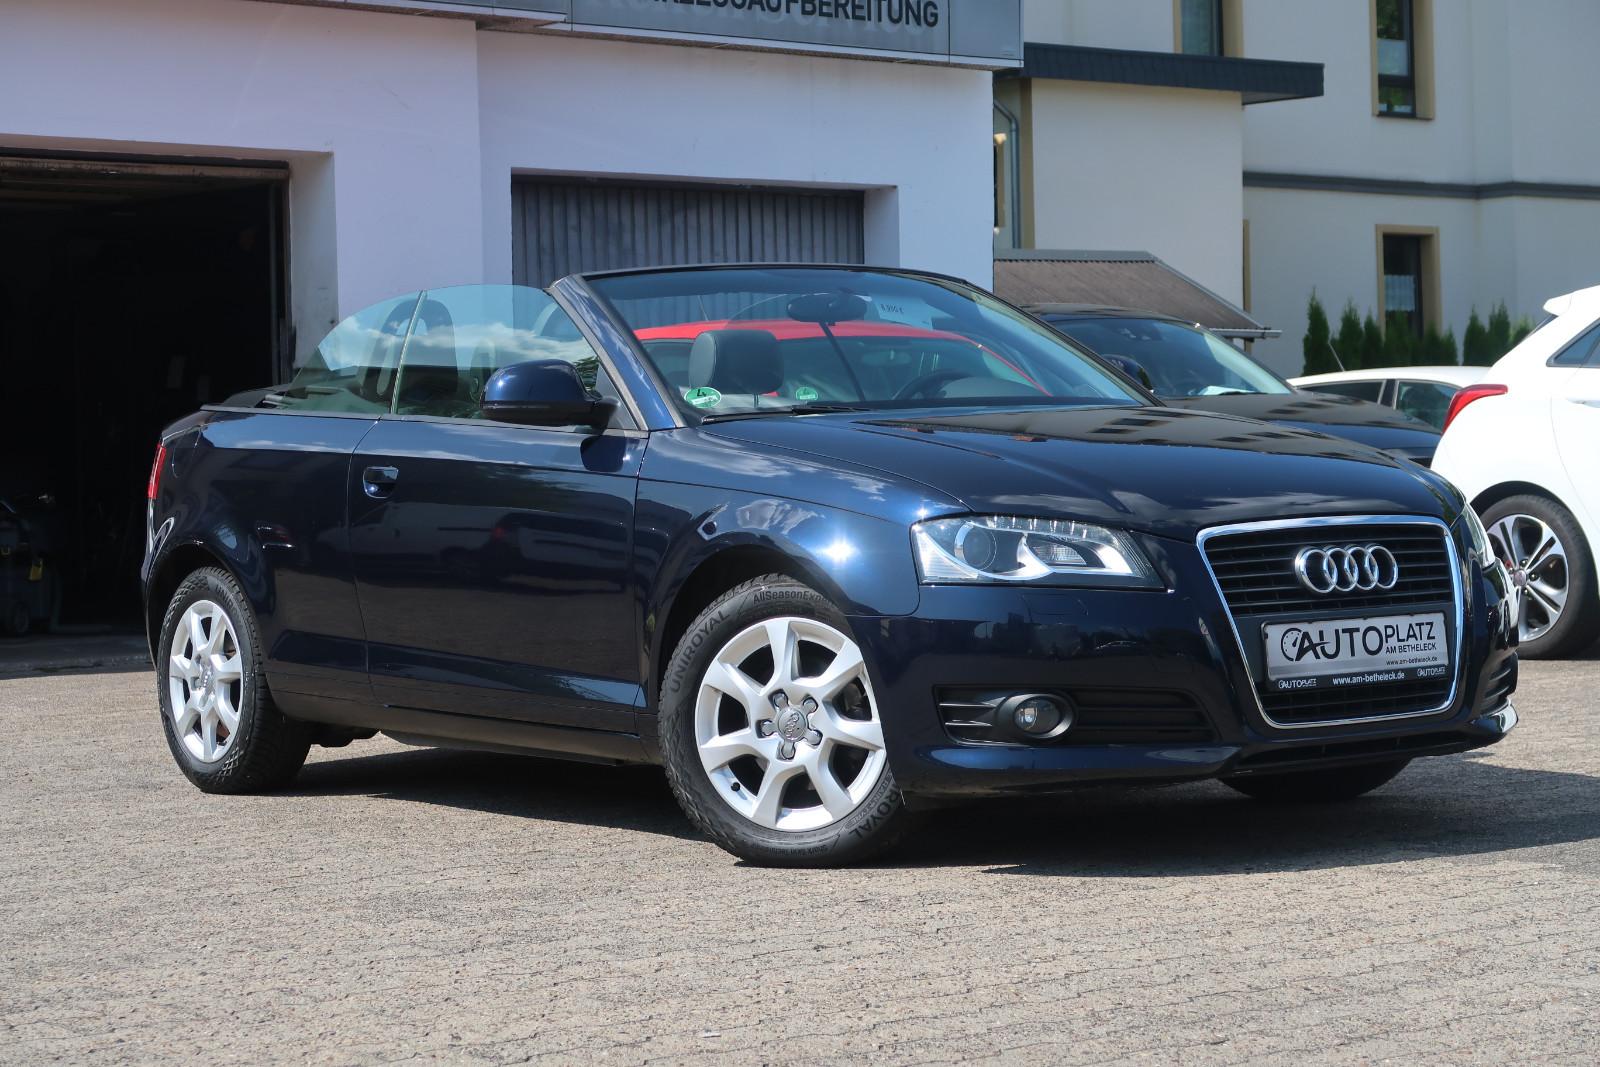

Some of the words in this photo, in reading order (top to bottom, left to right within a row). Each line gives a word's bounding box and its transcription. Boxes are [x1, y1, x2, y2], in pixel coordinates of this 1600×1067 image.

[669, 609, 731, 693] UNIROYAL
[1385, 645, 1397, 655] AM
[1398, 642, 1437, 653] BETHELECK
